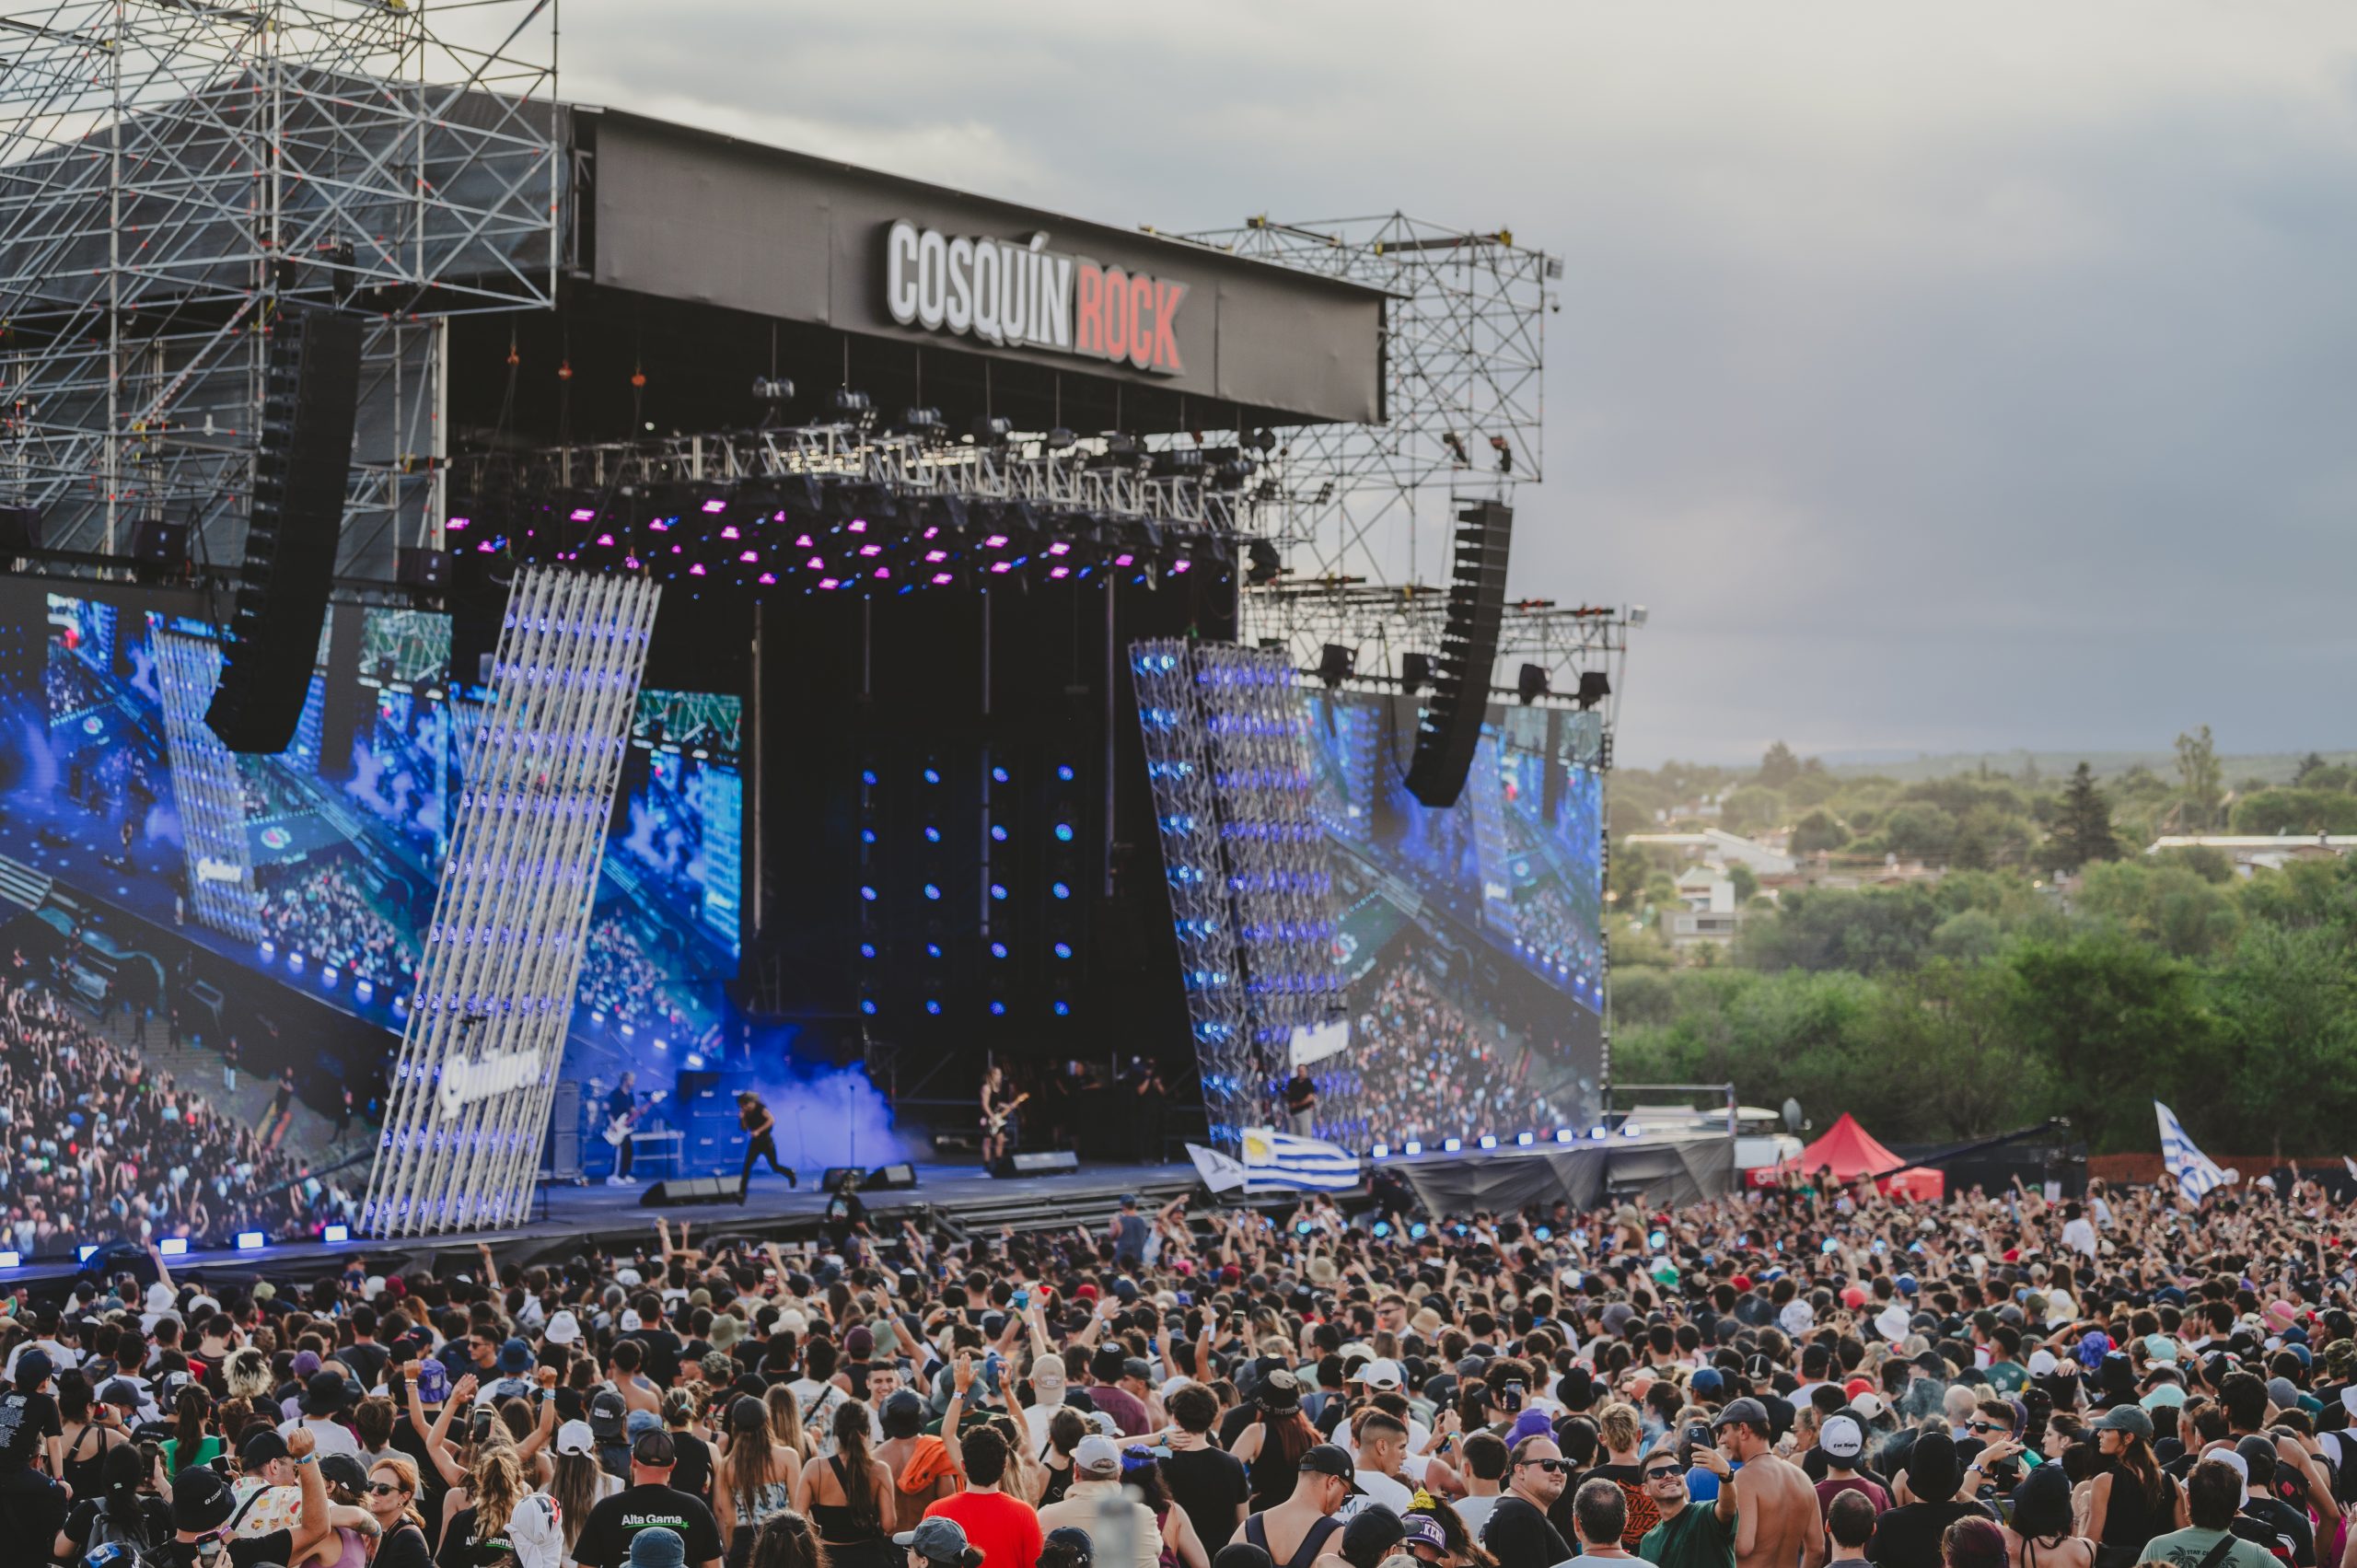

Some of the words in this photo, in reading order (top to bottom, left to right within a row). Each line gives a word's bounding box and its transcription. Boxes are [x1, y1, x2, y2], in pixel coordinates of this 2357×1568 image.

[888, 223, 1072, 348] COSQUÍN
[1078, 264, 1186, 370] ROCK
[621, 1514, 644, 1526] Alta
[645, 1514, 682, 1525] Gama
[1422, 1522, 1444, 1545] KERS
